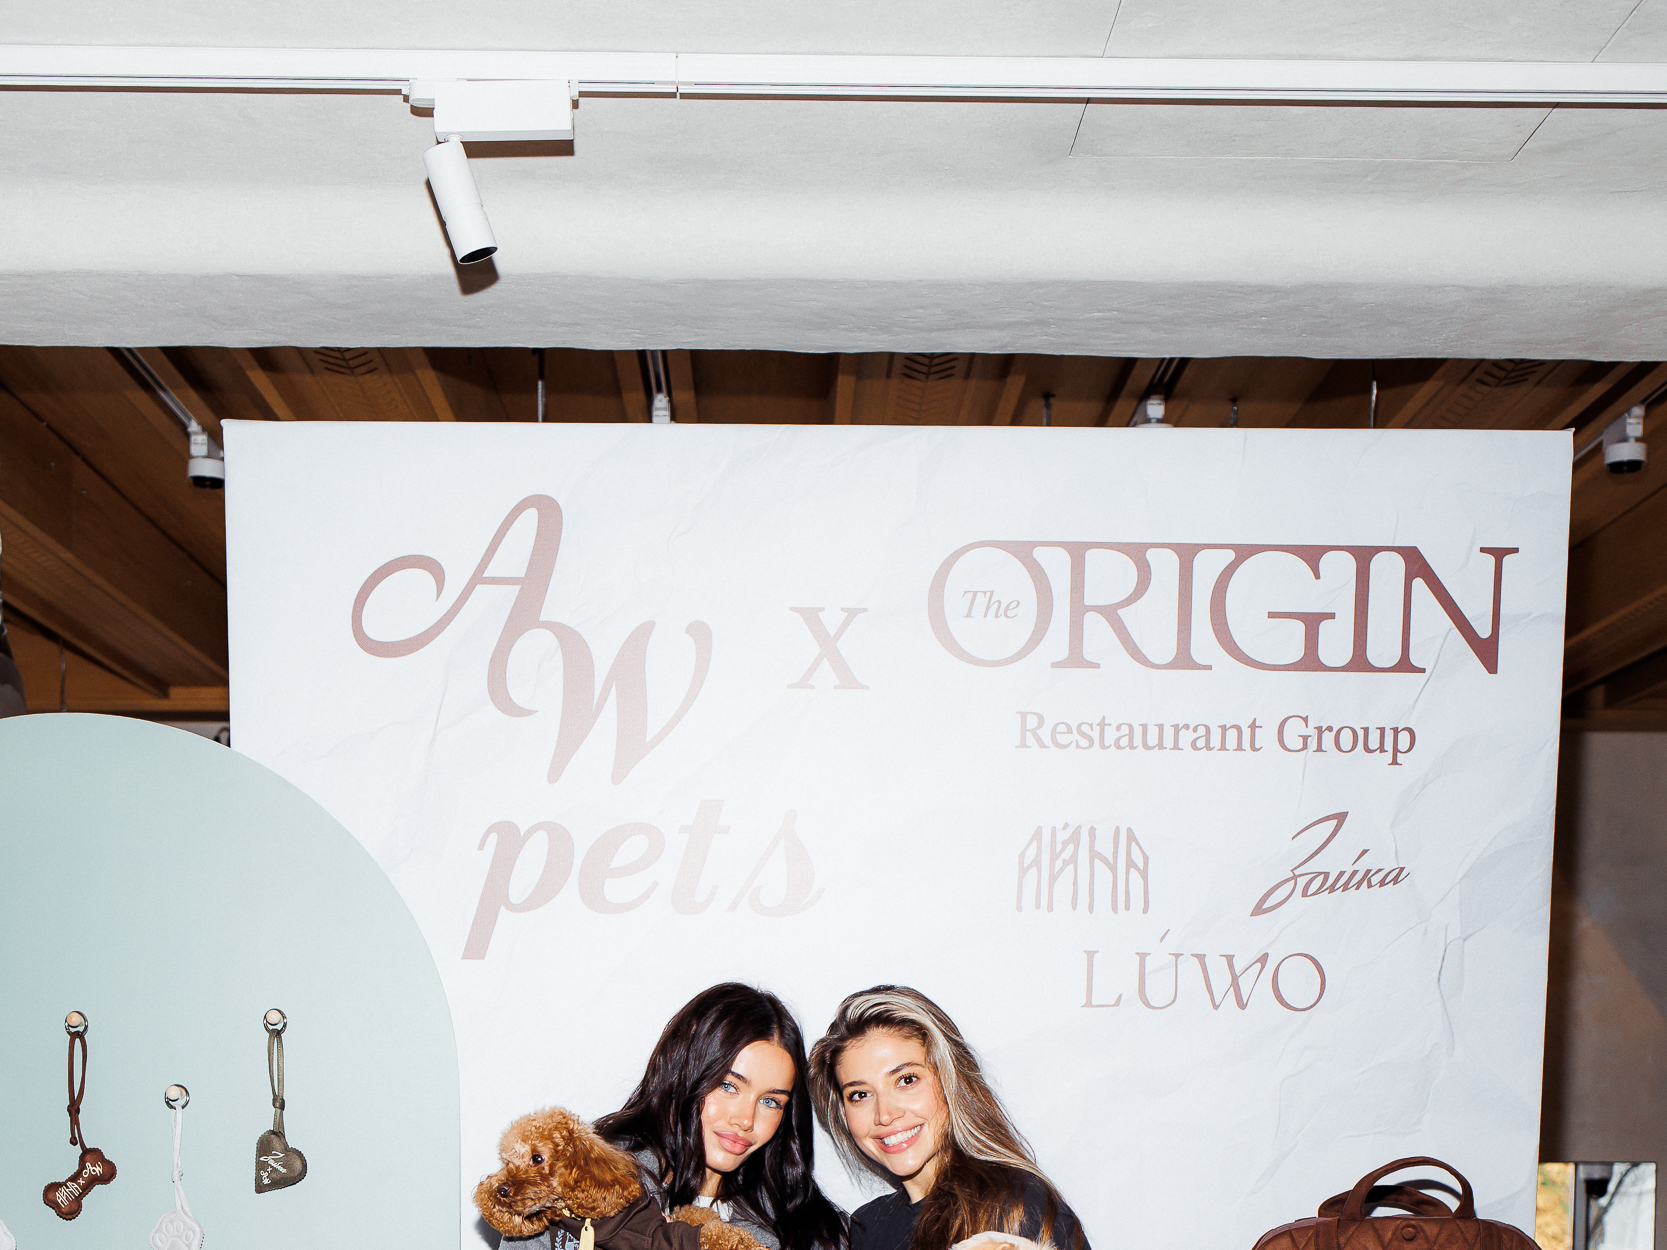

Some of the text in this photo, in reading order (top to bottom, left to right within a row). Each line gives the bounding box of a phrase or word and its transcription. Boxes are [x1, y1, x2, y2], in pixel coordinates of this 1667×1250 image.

[927, 540, 1520, 675] ORIGIN
[961, 590, 1021, 619] The
[1015, 711, 1417, 766] Restaurant Group
[461, 799, 826, 960] pets
